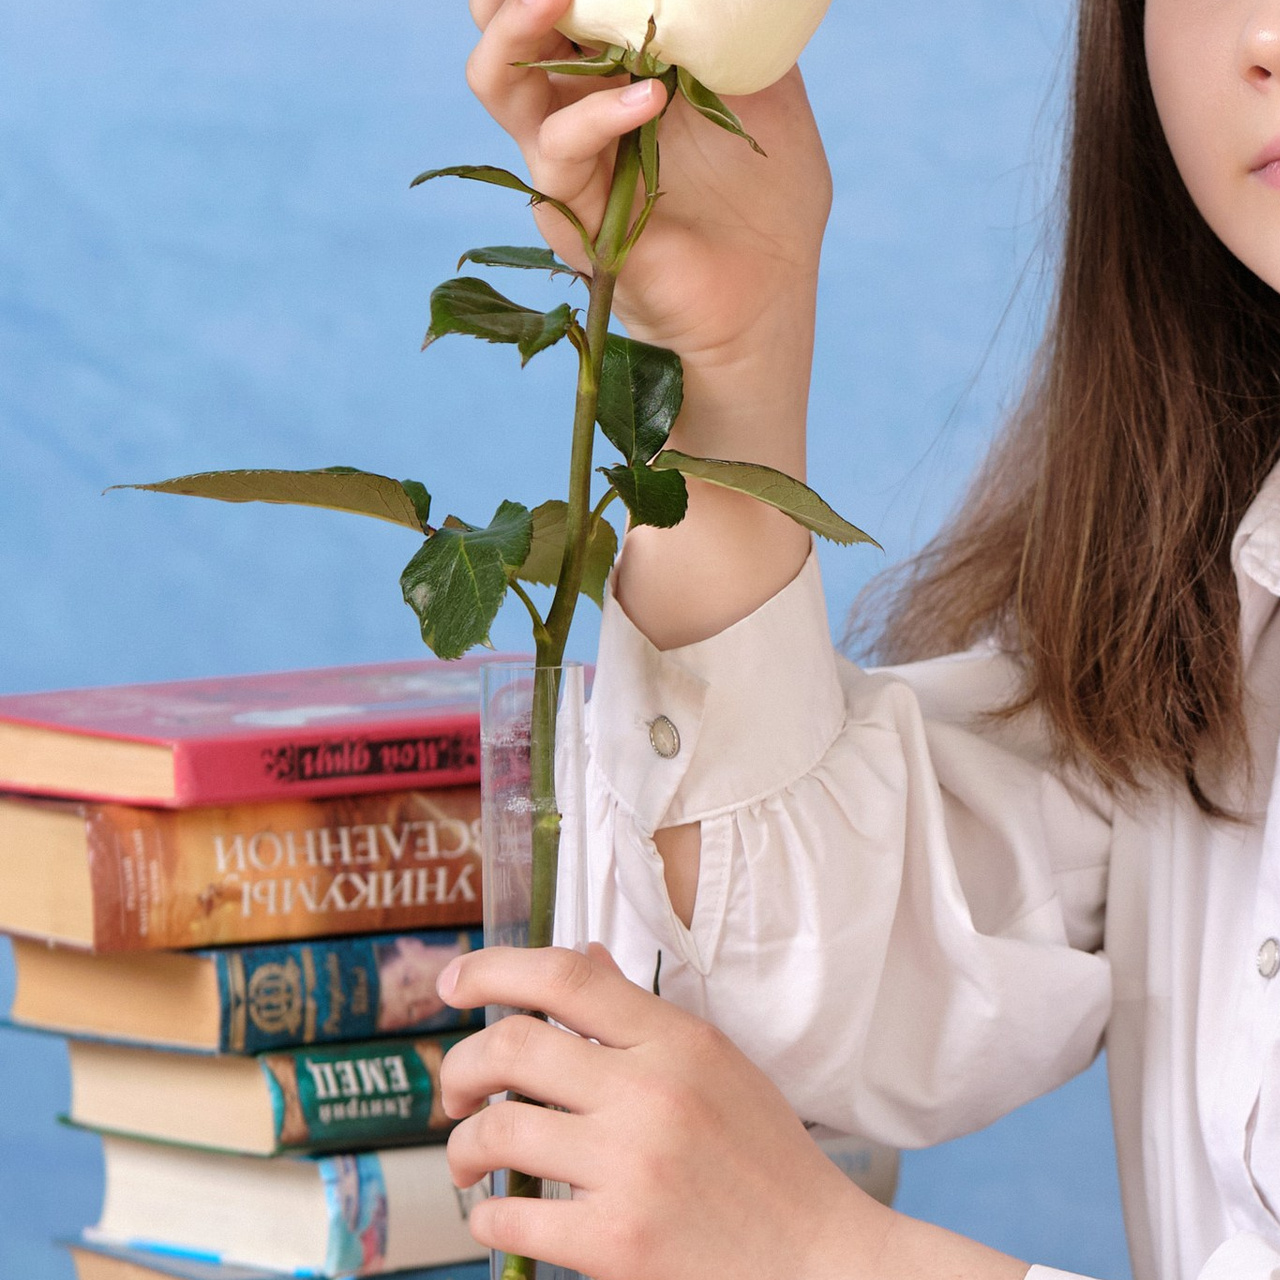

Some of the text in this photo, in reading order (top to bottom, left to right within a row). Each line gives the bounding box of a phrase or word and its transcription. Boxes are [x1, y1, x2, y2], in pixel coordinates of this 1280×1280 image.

[302, 735, 449, 778] Мой друг
[240, 863, 476, 918] УНИКУМЫ
[305, 1055, 411, 1099] ЕМЕЦ
[317, 1094, 414, 1124] Дмитрий
